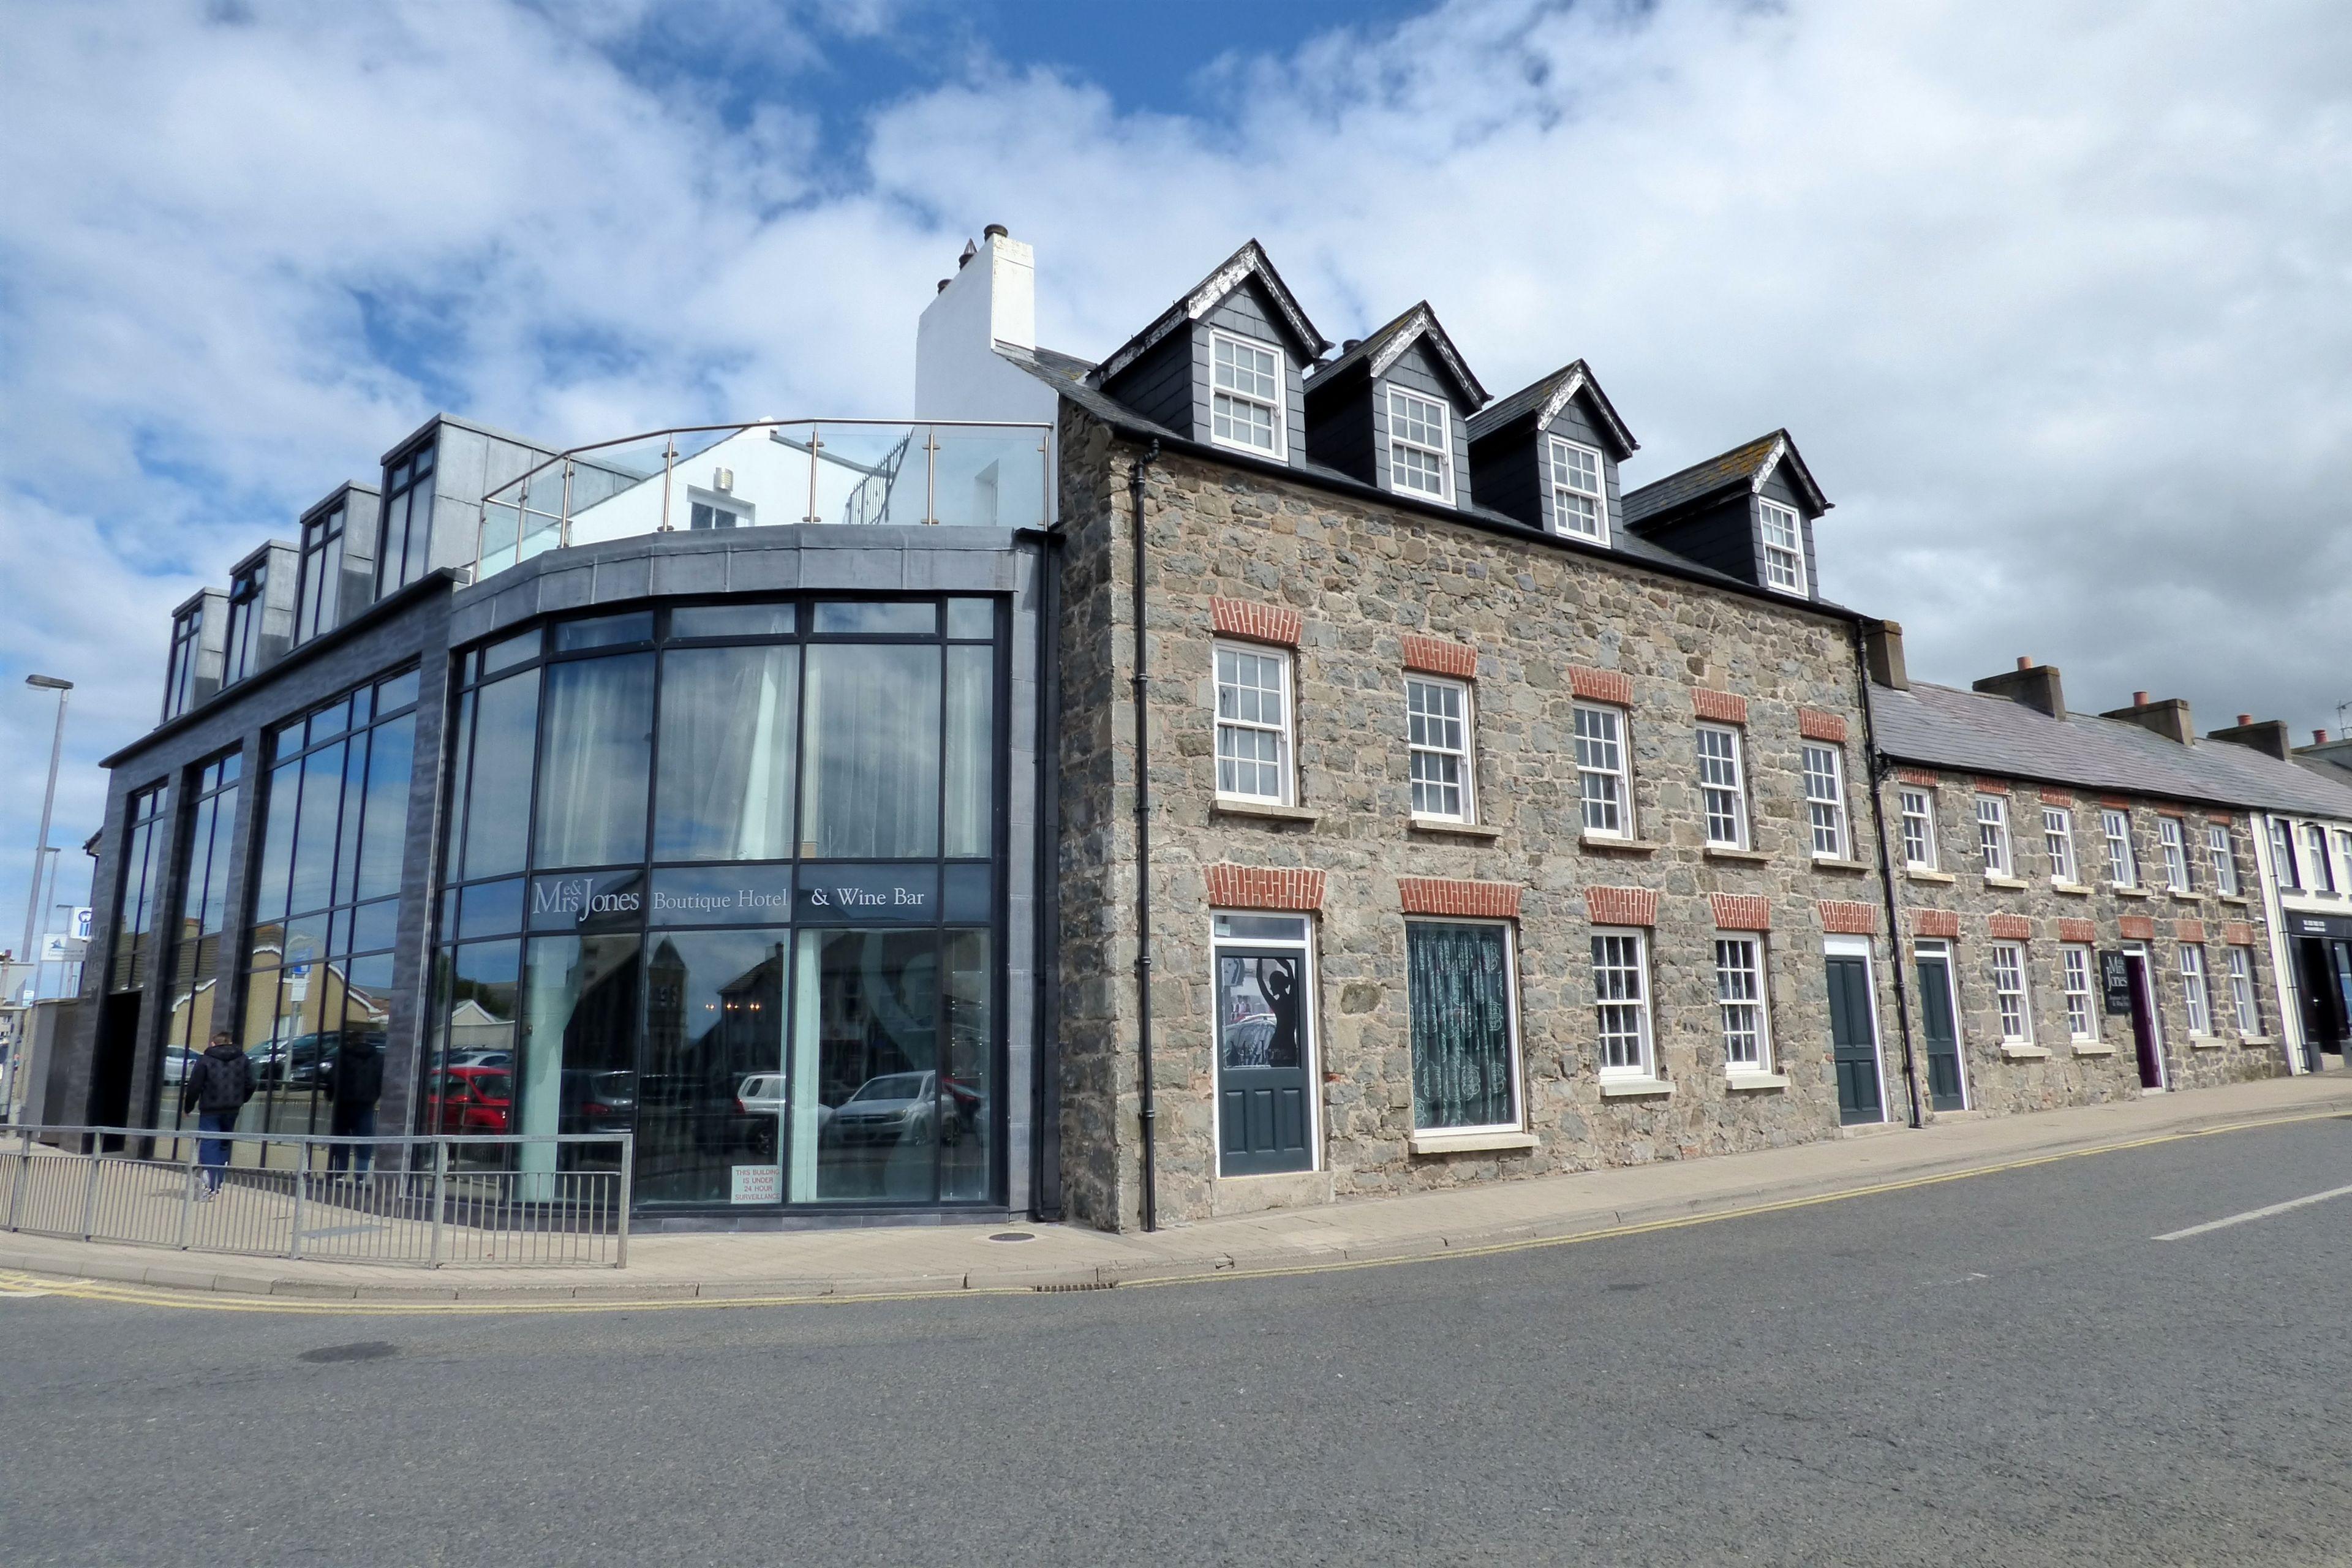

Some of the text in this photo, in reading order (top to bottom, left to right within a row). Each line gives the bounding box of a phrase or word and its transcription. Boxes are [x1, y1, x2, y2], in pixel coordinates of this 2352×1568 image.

[579, 878, 639, 922] Jones
[654, 892, 731, 912] Boutique
[738, 888, 788, 907] Hotel
[812, 888, 830, 905] &
[837, 888, 886, 905] Wine
[894, 888, 925, 905] Bar
